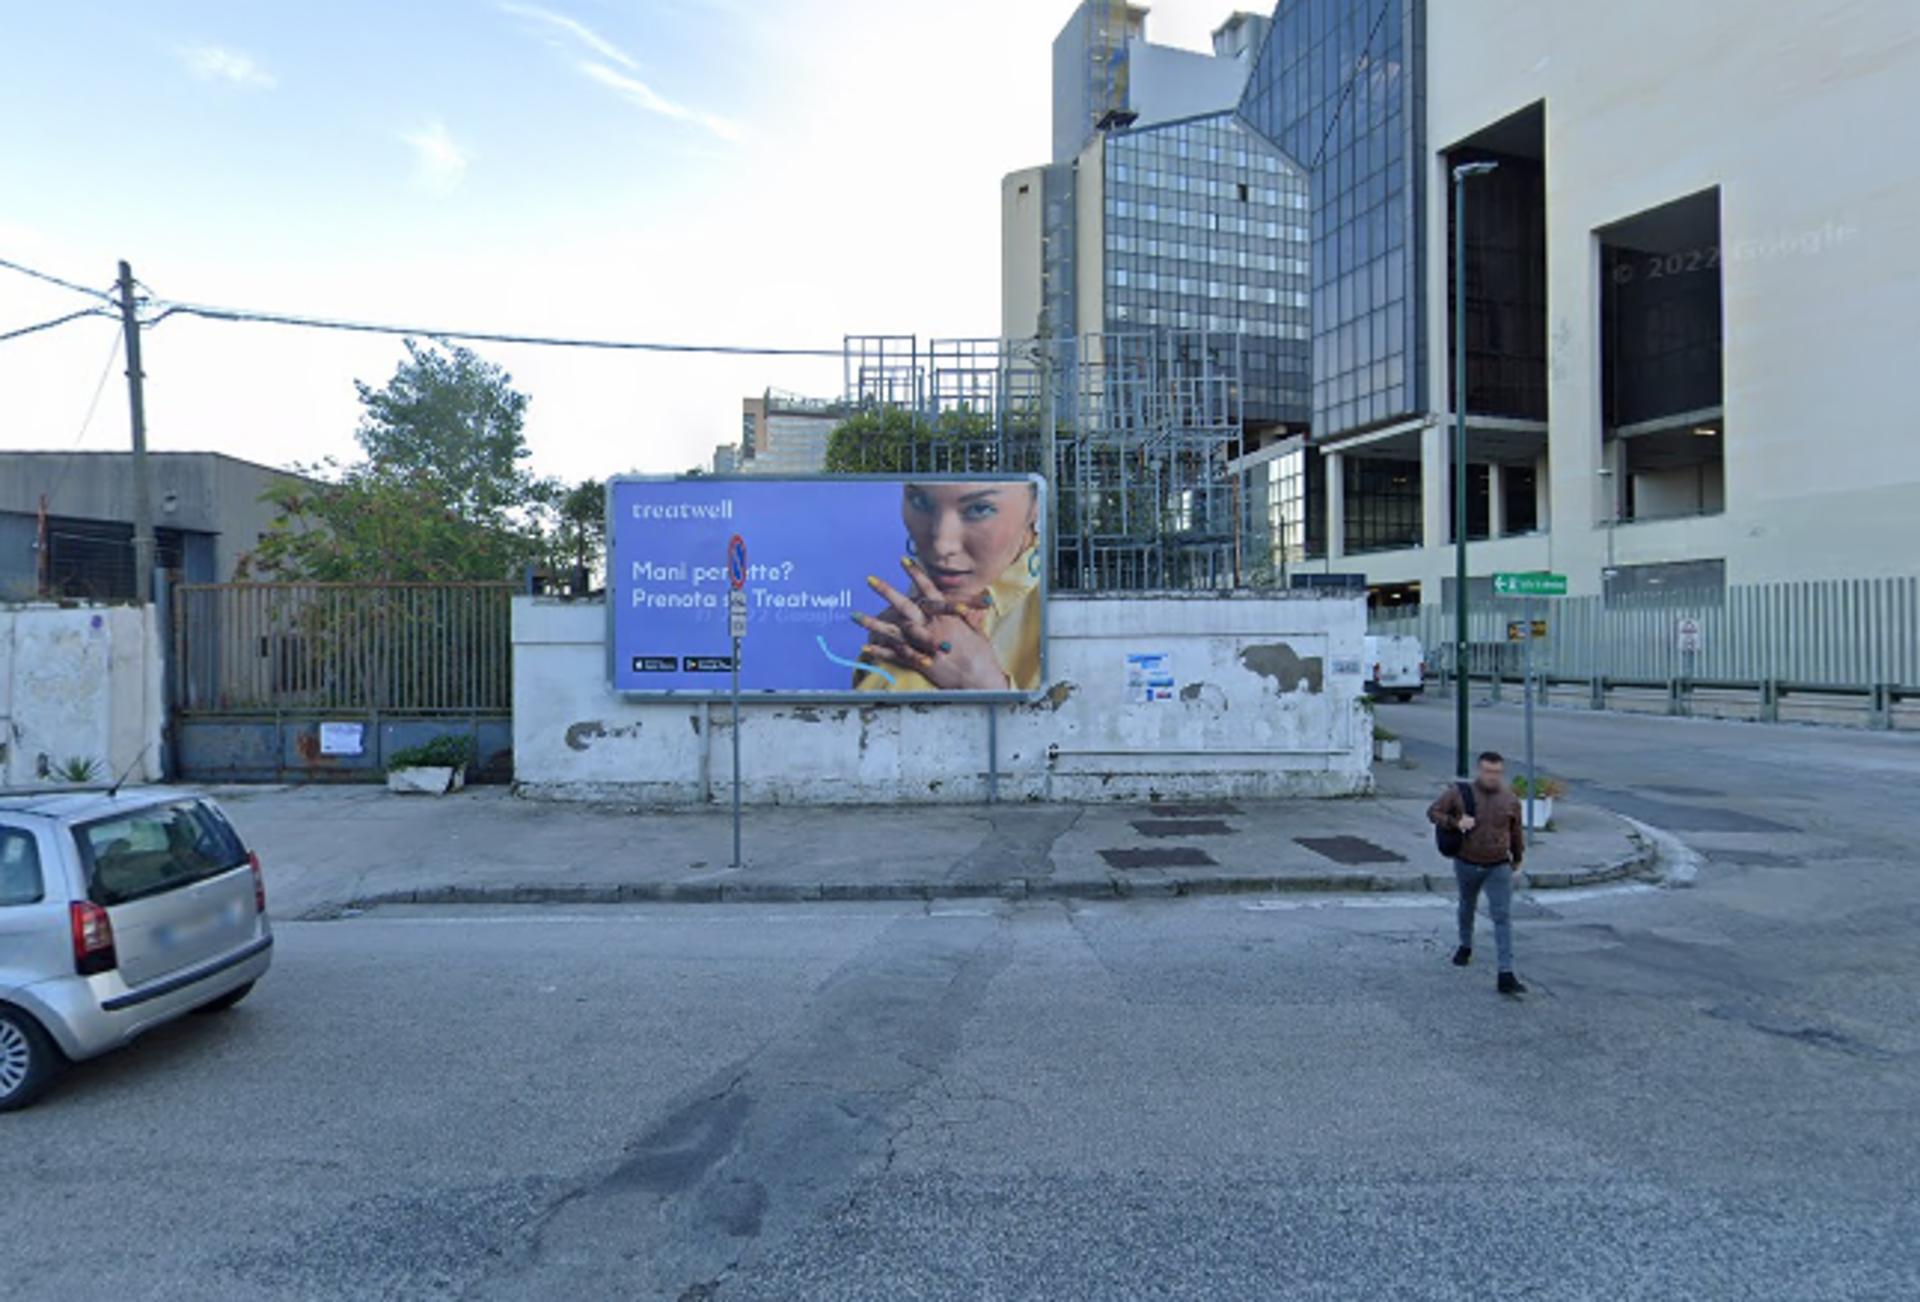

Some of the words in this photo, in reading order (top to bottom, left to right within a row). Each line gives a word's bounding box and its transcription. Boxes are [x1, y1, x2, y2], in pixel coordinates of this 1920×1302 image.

[632, 500, 732, 519] treatwell
[632, 562, 687, 580] Mani
[693, 562, 795, 586] pertte?
[632, 588, 717, 608] Prenota
[752, 588, 851, 608] Treatwell
